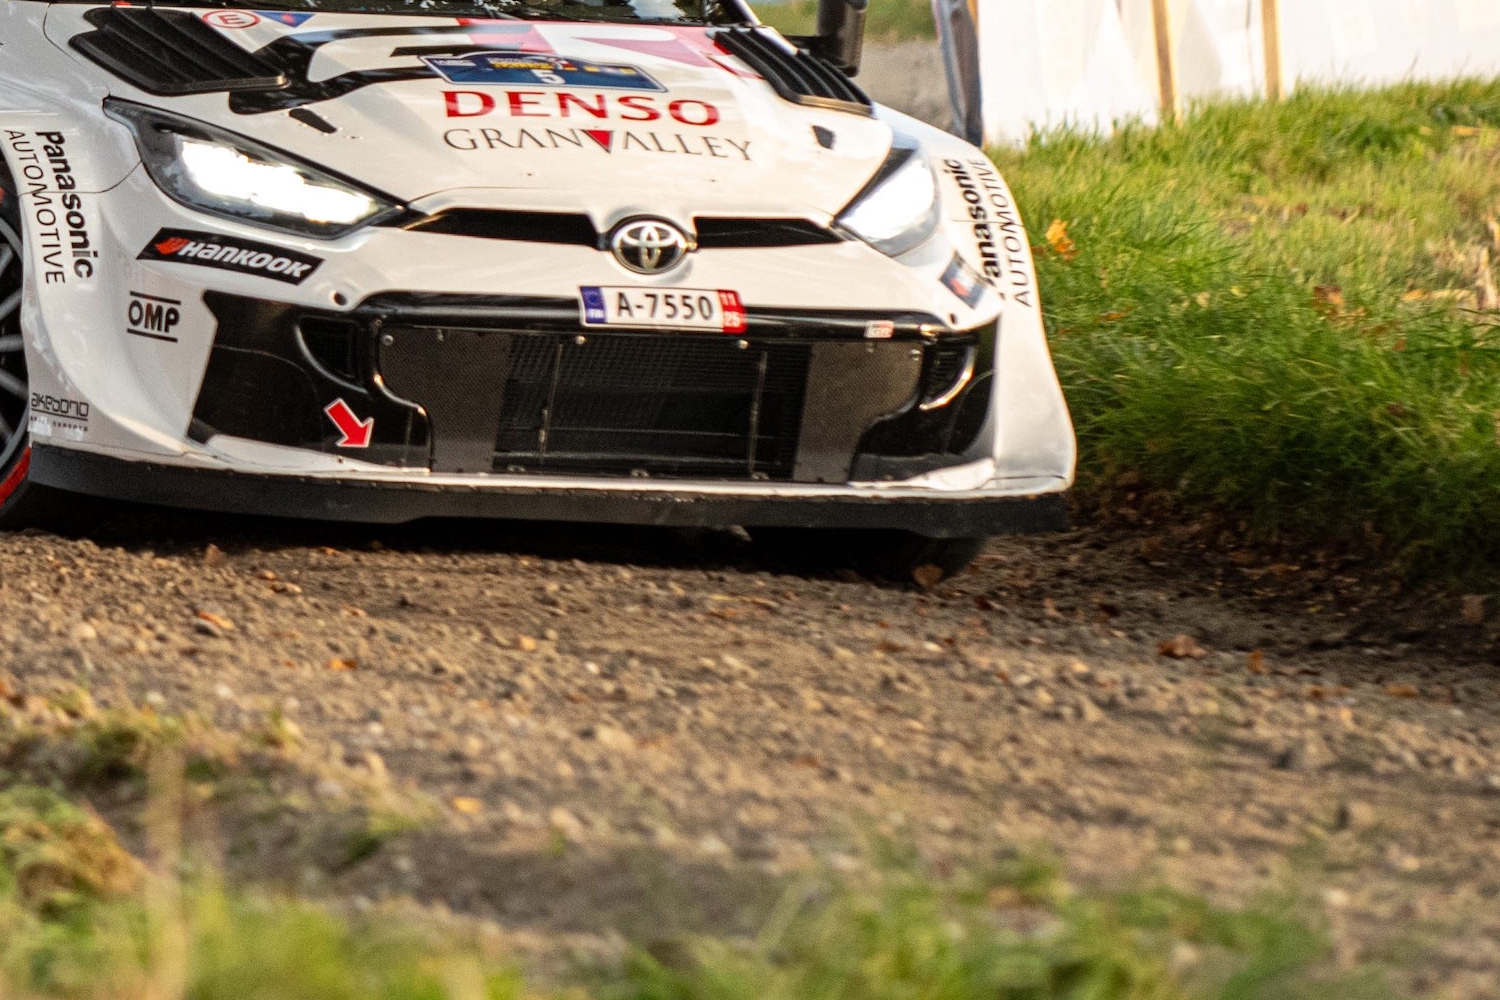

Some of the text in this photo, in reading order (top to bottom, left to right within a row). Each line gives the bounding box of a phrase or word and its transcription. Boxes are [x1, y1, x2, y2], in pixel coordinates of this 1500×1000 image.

[531, 69, 566, 84] 5
[442, 91, 720, 126] DENSO
[4, 129, 66, 285] AUTOMOTIVE
[35, 131, 99, 279] Panasonic
[967, 158, 1033, 308] AUTOMOTIVE
[128, 300, 180, 333] OMP
[617, 291, 714, 321] A-7550
[724, 311, 741, 328] 25
